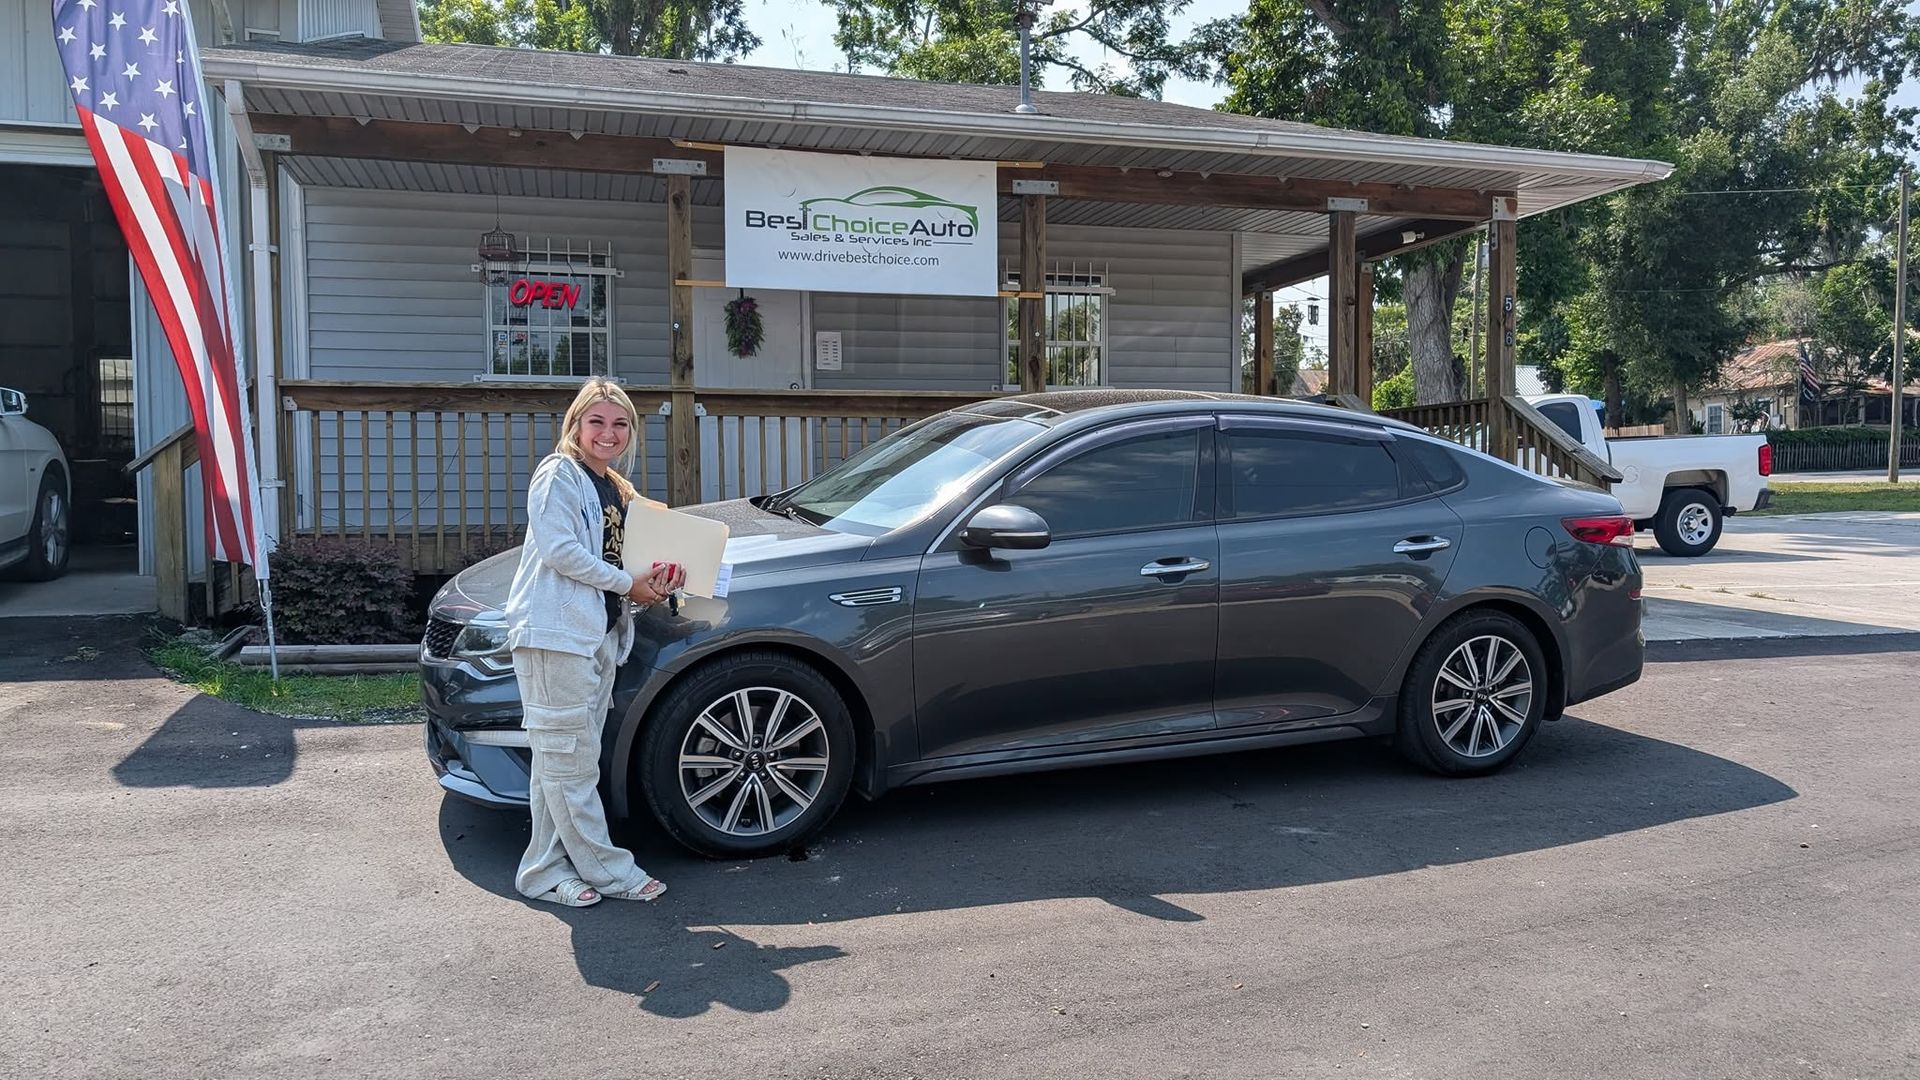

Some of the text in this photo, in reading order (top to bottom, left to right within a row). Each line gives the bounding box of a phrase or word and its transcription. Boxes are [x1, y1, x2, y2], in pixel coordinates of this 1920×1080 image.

[790, 231, 932, 247] Sales & Services Inc
[778, 249, 940, 267] www.drivebestchoice.com
[510, 279, 581, 310] OPEN
